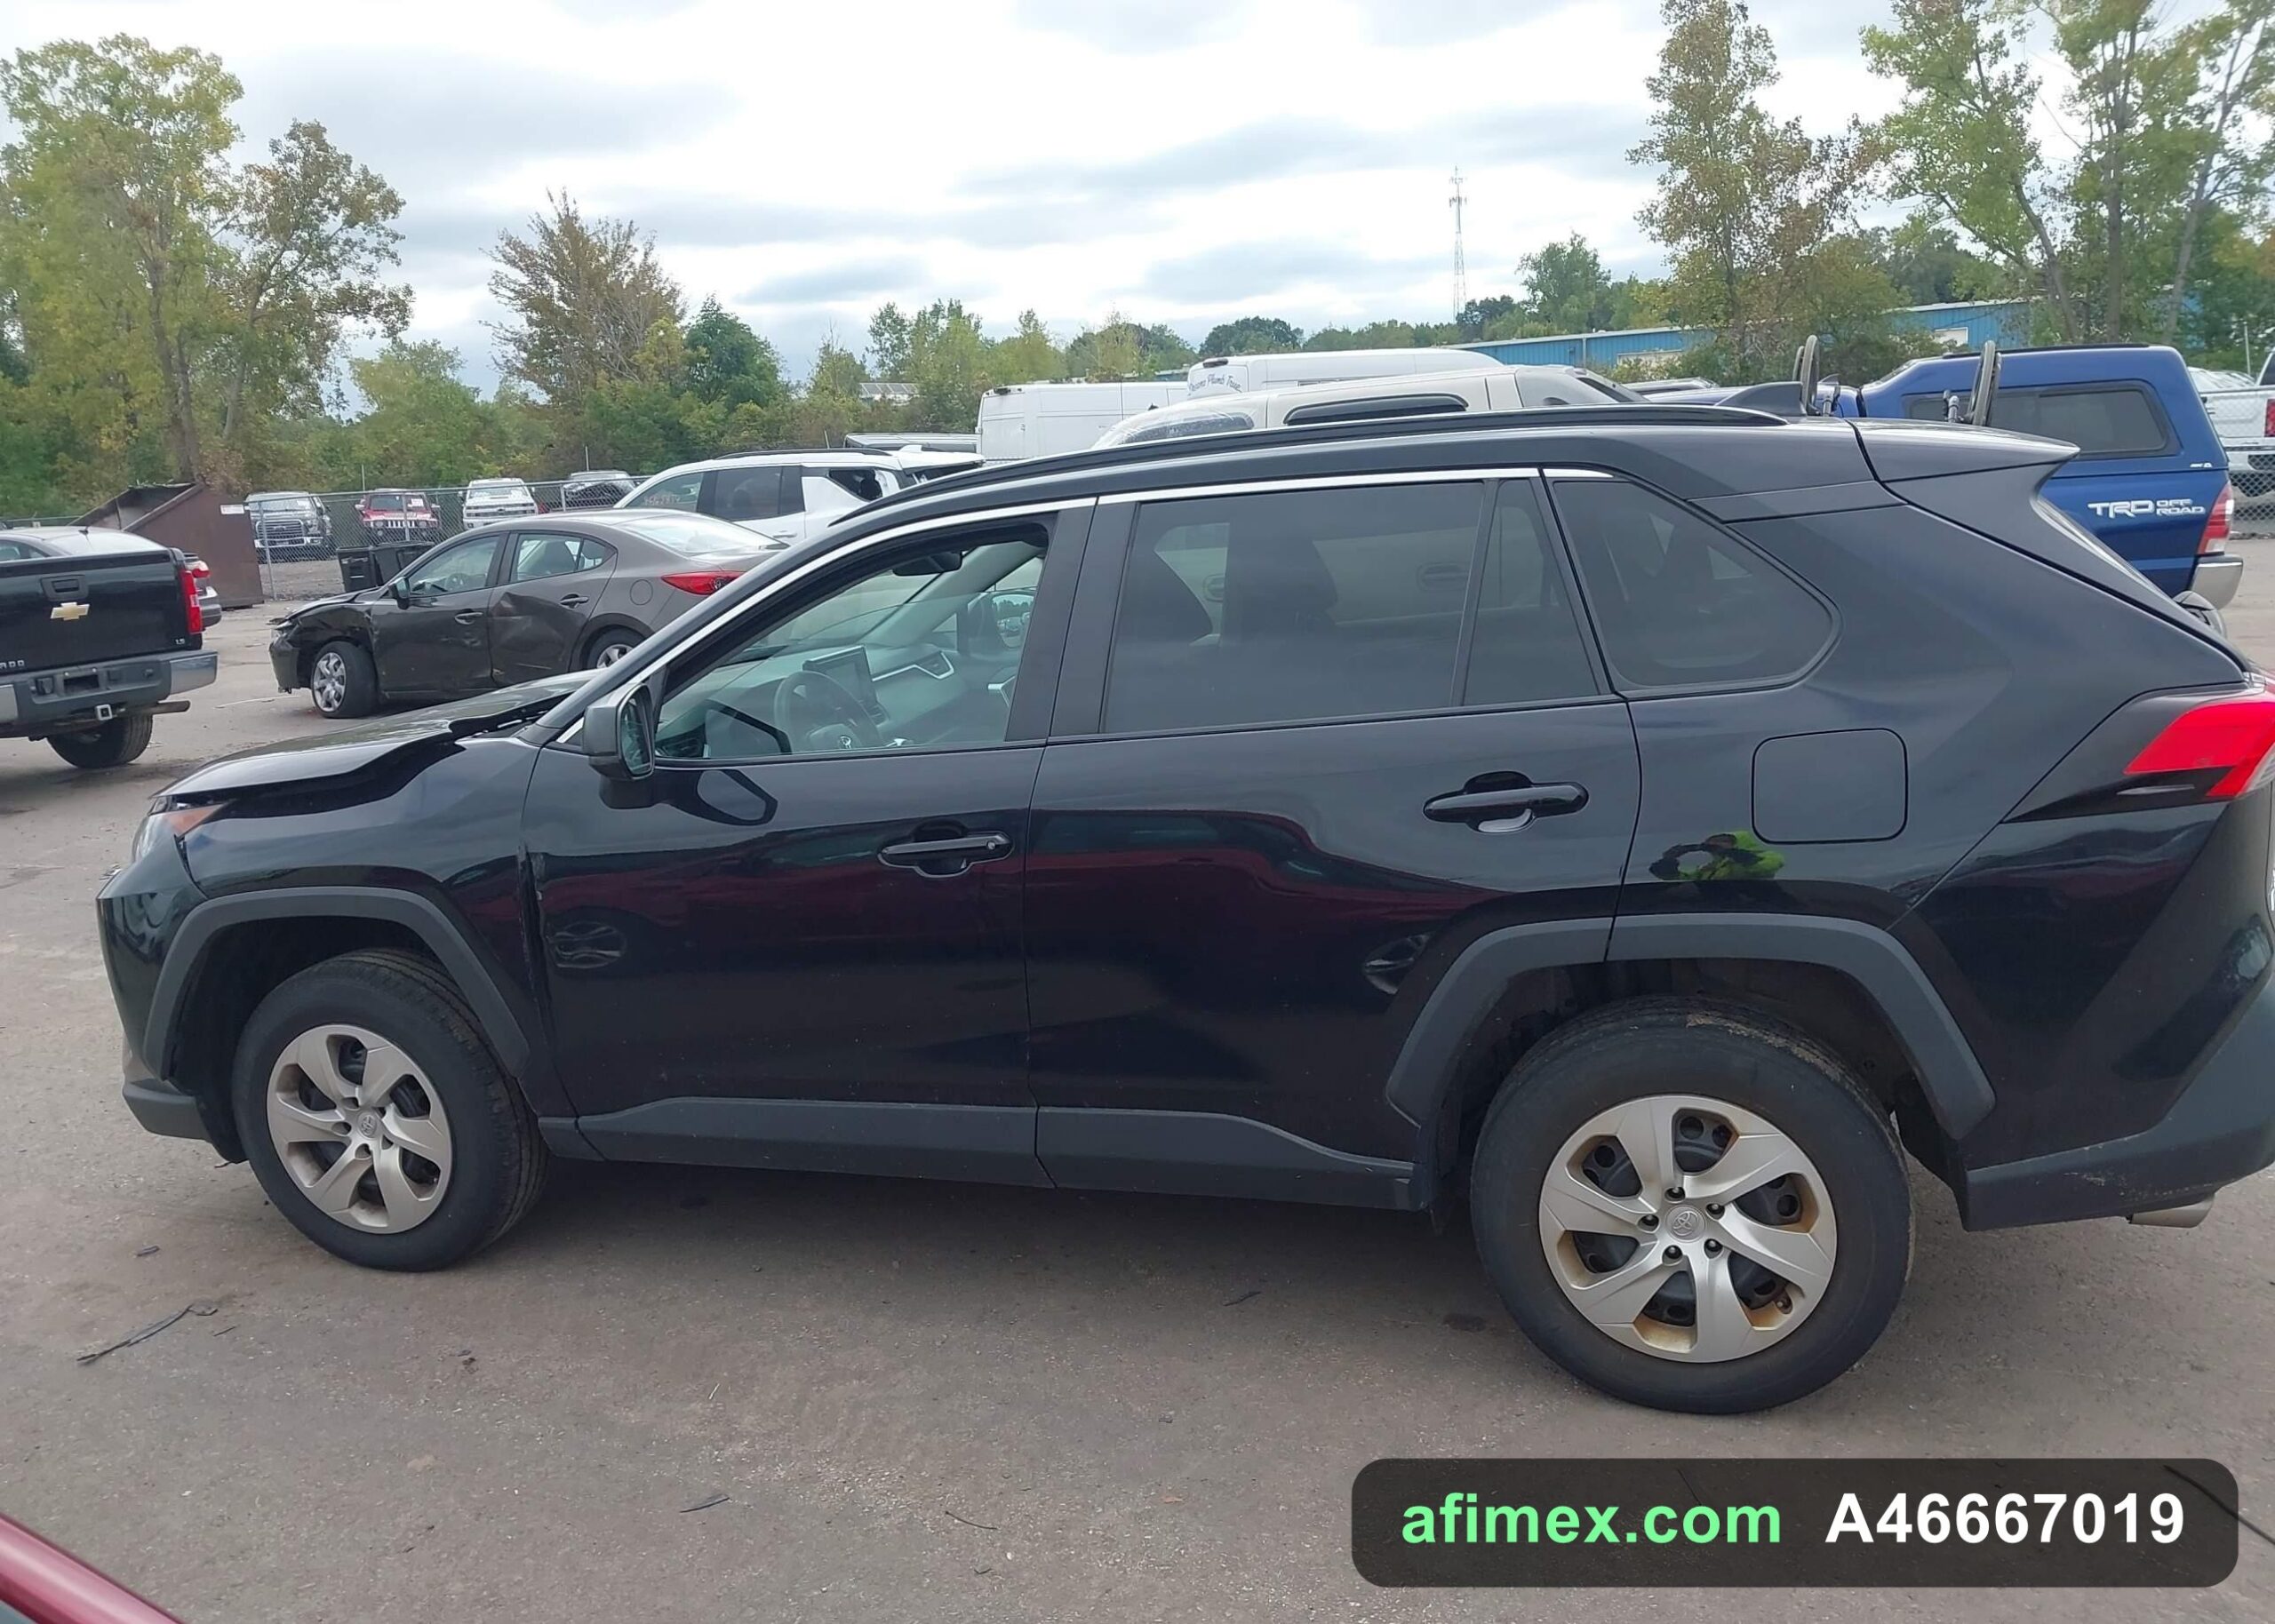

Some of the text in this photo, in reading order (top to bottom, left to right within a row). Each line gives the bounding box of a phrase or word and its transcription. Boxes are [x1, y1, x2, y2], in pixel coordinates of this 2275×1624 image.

[2156, 498, 2193, 507] OFF
[2087, 499, 2155, 519] TRD
[2156, 506, 2206, 516] ROAD
